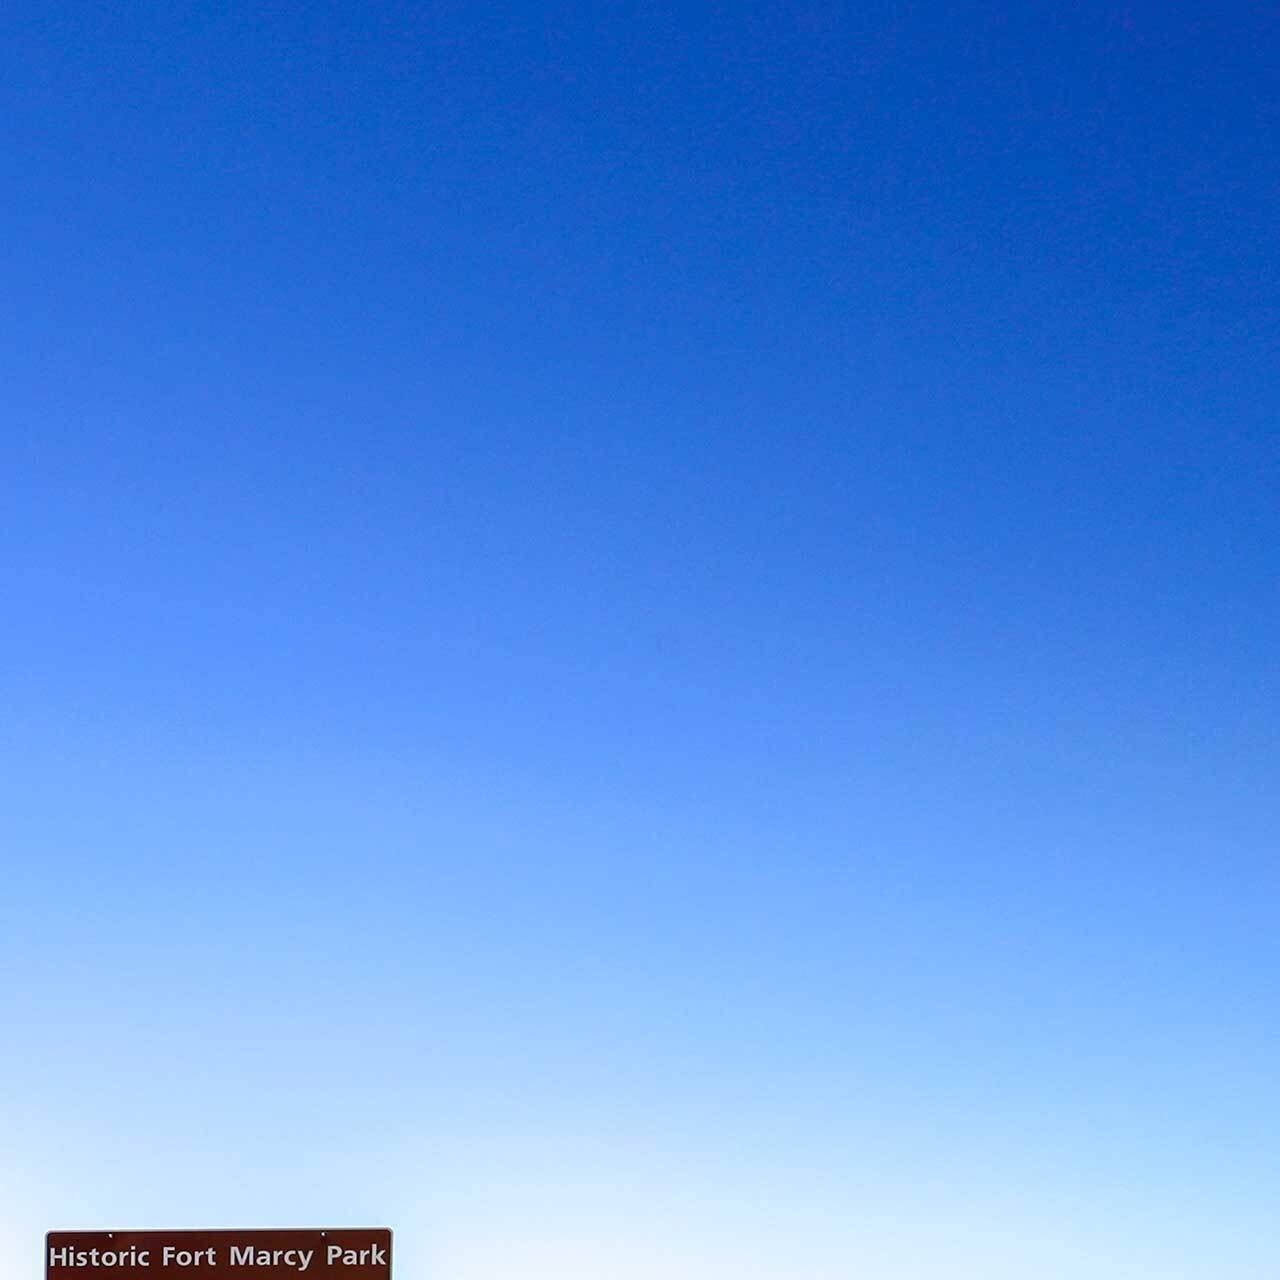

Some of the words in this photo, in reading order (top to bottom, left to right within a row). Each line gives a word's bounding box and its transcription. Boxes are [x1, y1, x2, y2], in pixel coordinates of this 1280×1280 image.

[49, 1245, 150, 1267] Historic
[162, 1246, 217, 1267] Fort
[229, 1245, 314, 1272] Marcy
[327, 1243, 387, 1266] Park
